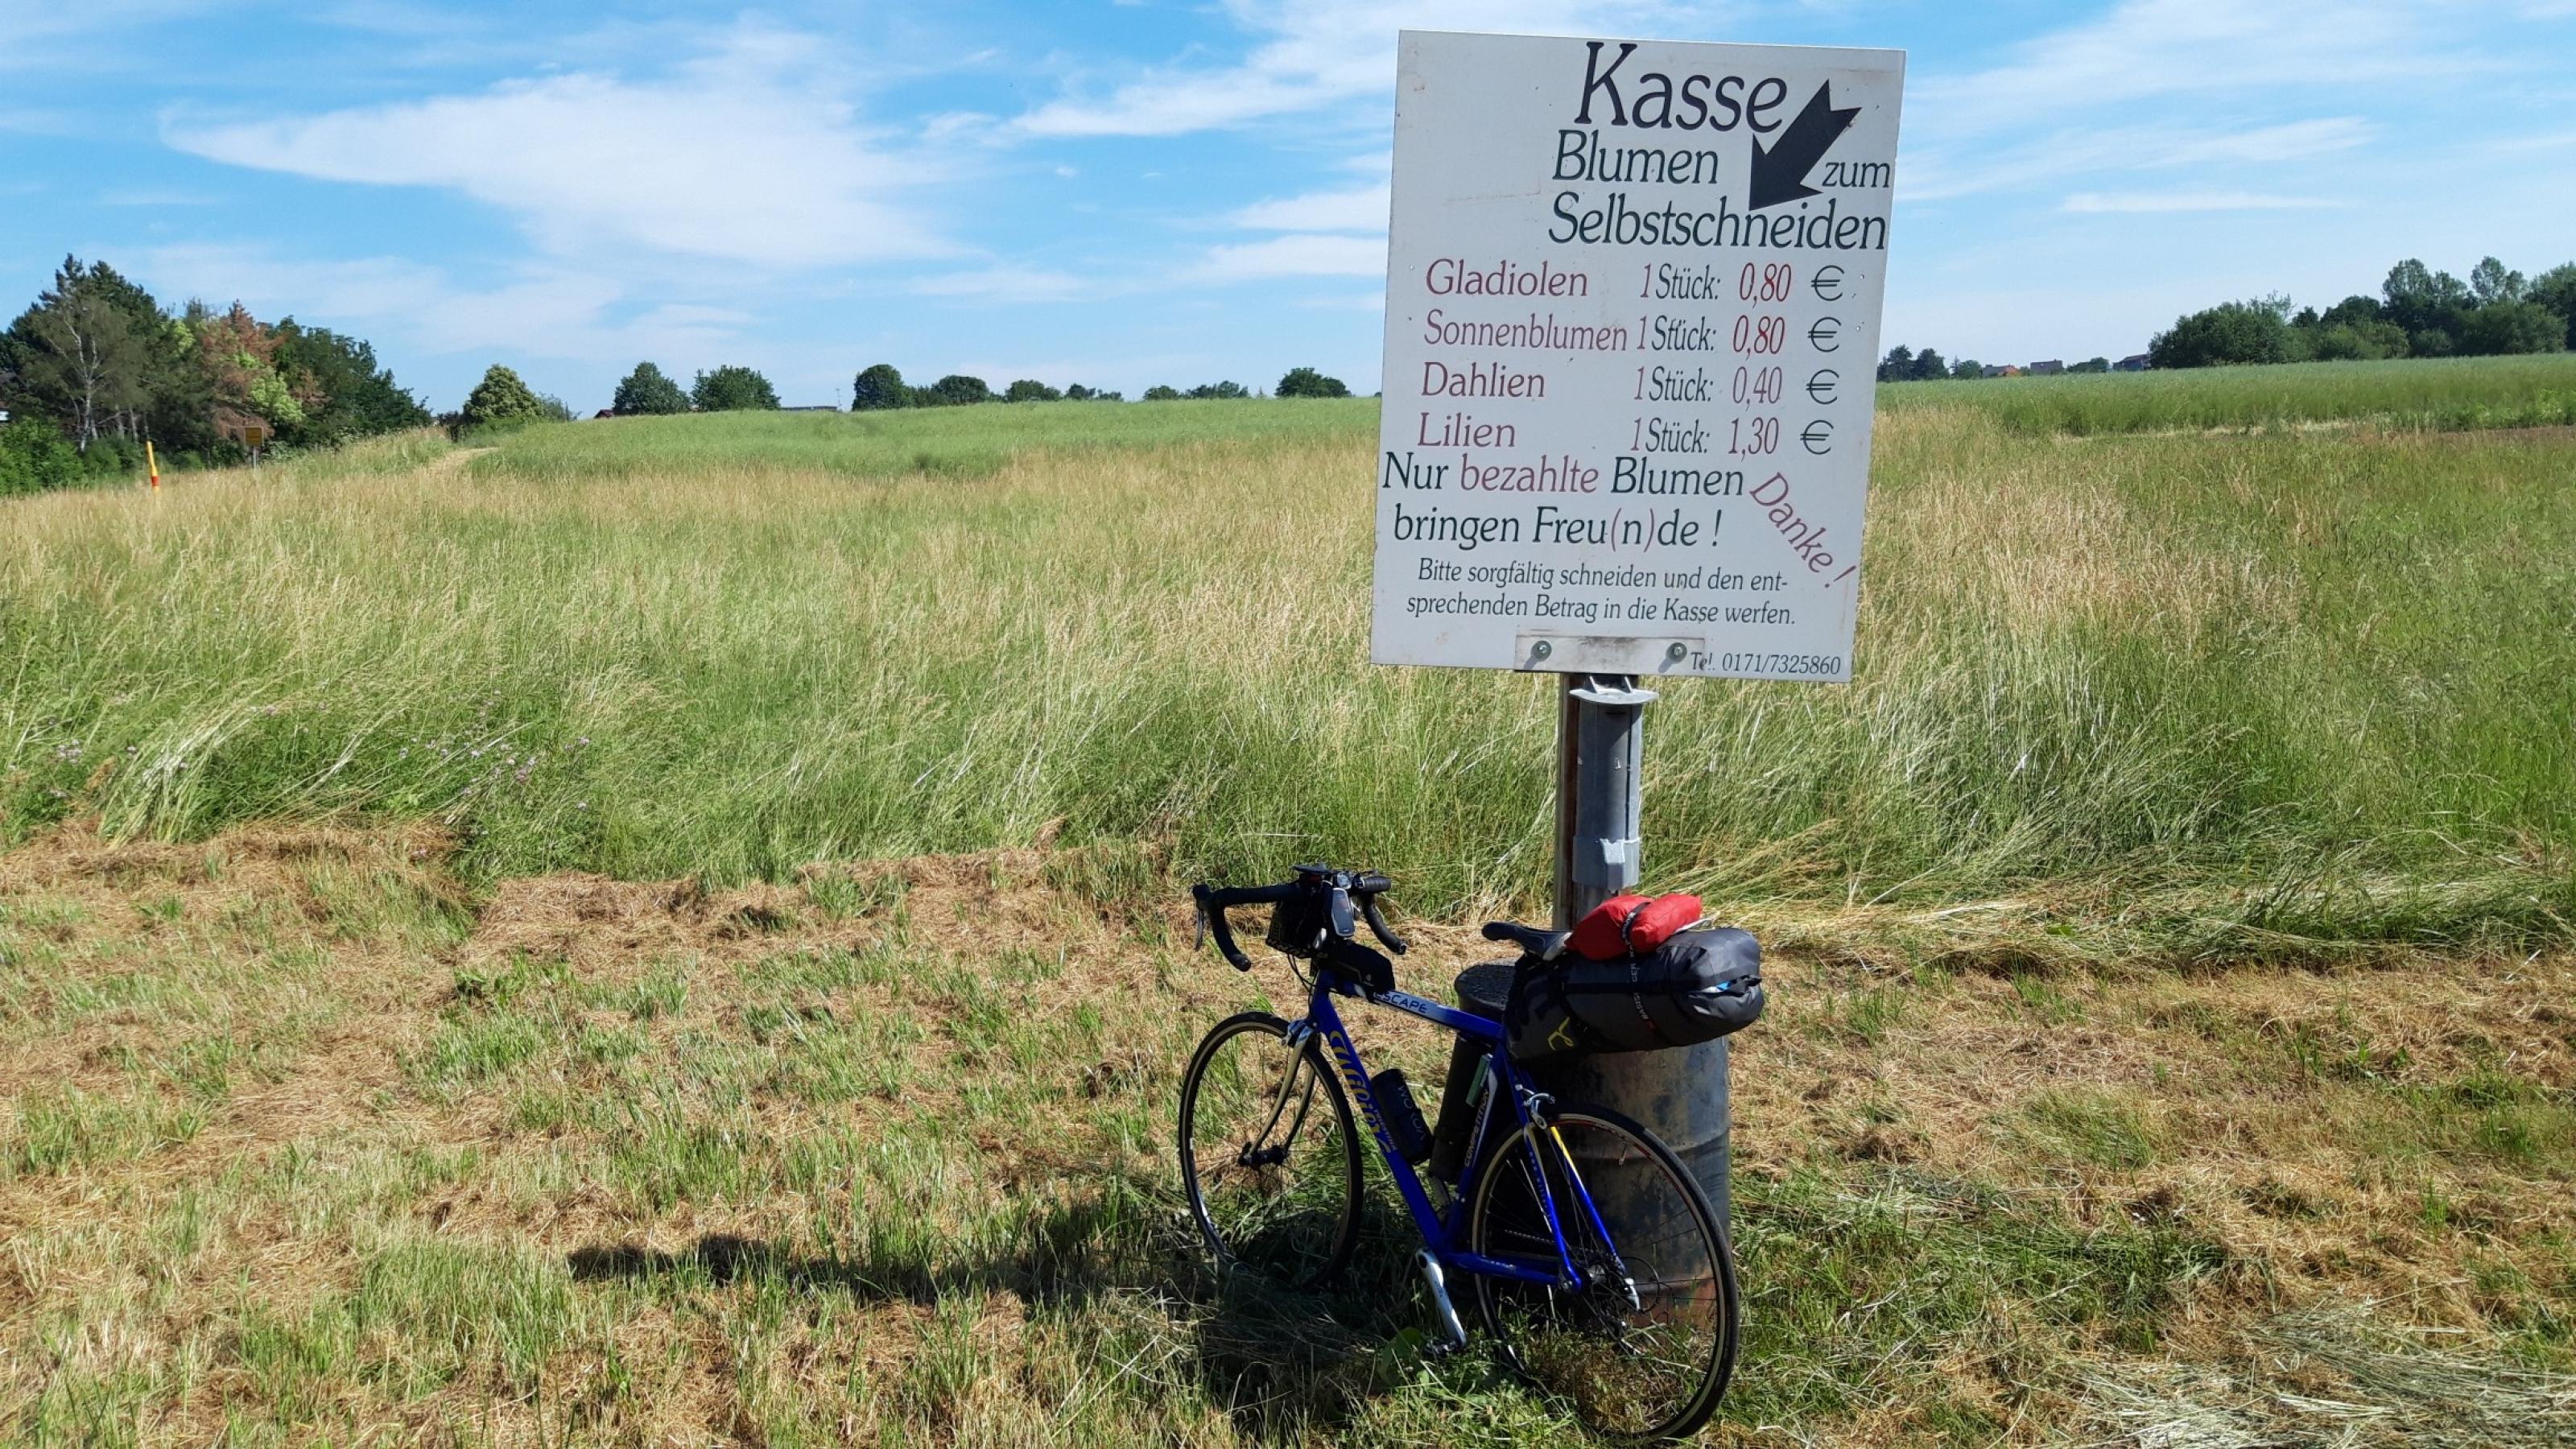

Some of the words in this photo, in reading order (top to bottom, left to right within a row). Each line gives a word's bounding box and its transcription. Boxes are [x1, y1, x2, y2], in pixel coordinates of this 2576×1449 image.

[1574, 40, 1788, 134] Kasse
[1551, 129, 1719, 185] Blumen
[1821, 161, 1891, 188] zum
[1547, 190, 1886, 251] Selbstschneiden
[1426, 258, 1587, 296] Gladiolen
[1739, 262, 1792, 309] 0,80
[1810, 264, 1845, 302] €
[1423, 308, 1628, 352] Sonnenblumen
[1732, 314, 1785, 361] 0,80
[1806, 316, 1842, 353] €
[1421, 361, 1545, 398] Dahlien
[1732, 365, 1783, 411] 0,40
[1805, 368, 1840, 406] €
[1417, 411, 1516, 448] Lilien
[1728, 417, 1780, 462] 1,30
[1799, 419, 1835, 456] €
[1381, 451, 1450, 490] Nur
[1460, 452, 1600, 493] bezahlte
[1610, 456, 1744, 496] Blumen
[1393, 502, 1520, 551] bringen
[1532, 506, 1699, 553] Freu(n)de
[1711, 509, 1723, 547] !
[1749, 472, 1834, 573] Danke
[1418, 557, 1463, 582] Bitte
[1467, 559, 1555, 590] sorgfältig
[1558, 561, 1657, 588] schneiden
[1664, 564, 1703, 589] und
[1707, 566, 1744, 591] den
[1750, 570, 1788, 592] ent-
[1406, 591, 1528, 619] sprechenden
[1534, 593, 1599, 624] Betrag
[1604, 597, 1621, 619] in
[1627, 596, 1657, 621] die
[1663, 597, 1719, 623] Kasse
[1725, 598, 1796, 625] werfen.
[1722, 652, 1841, 675] 0171/7325860
